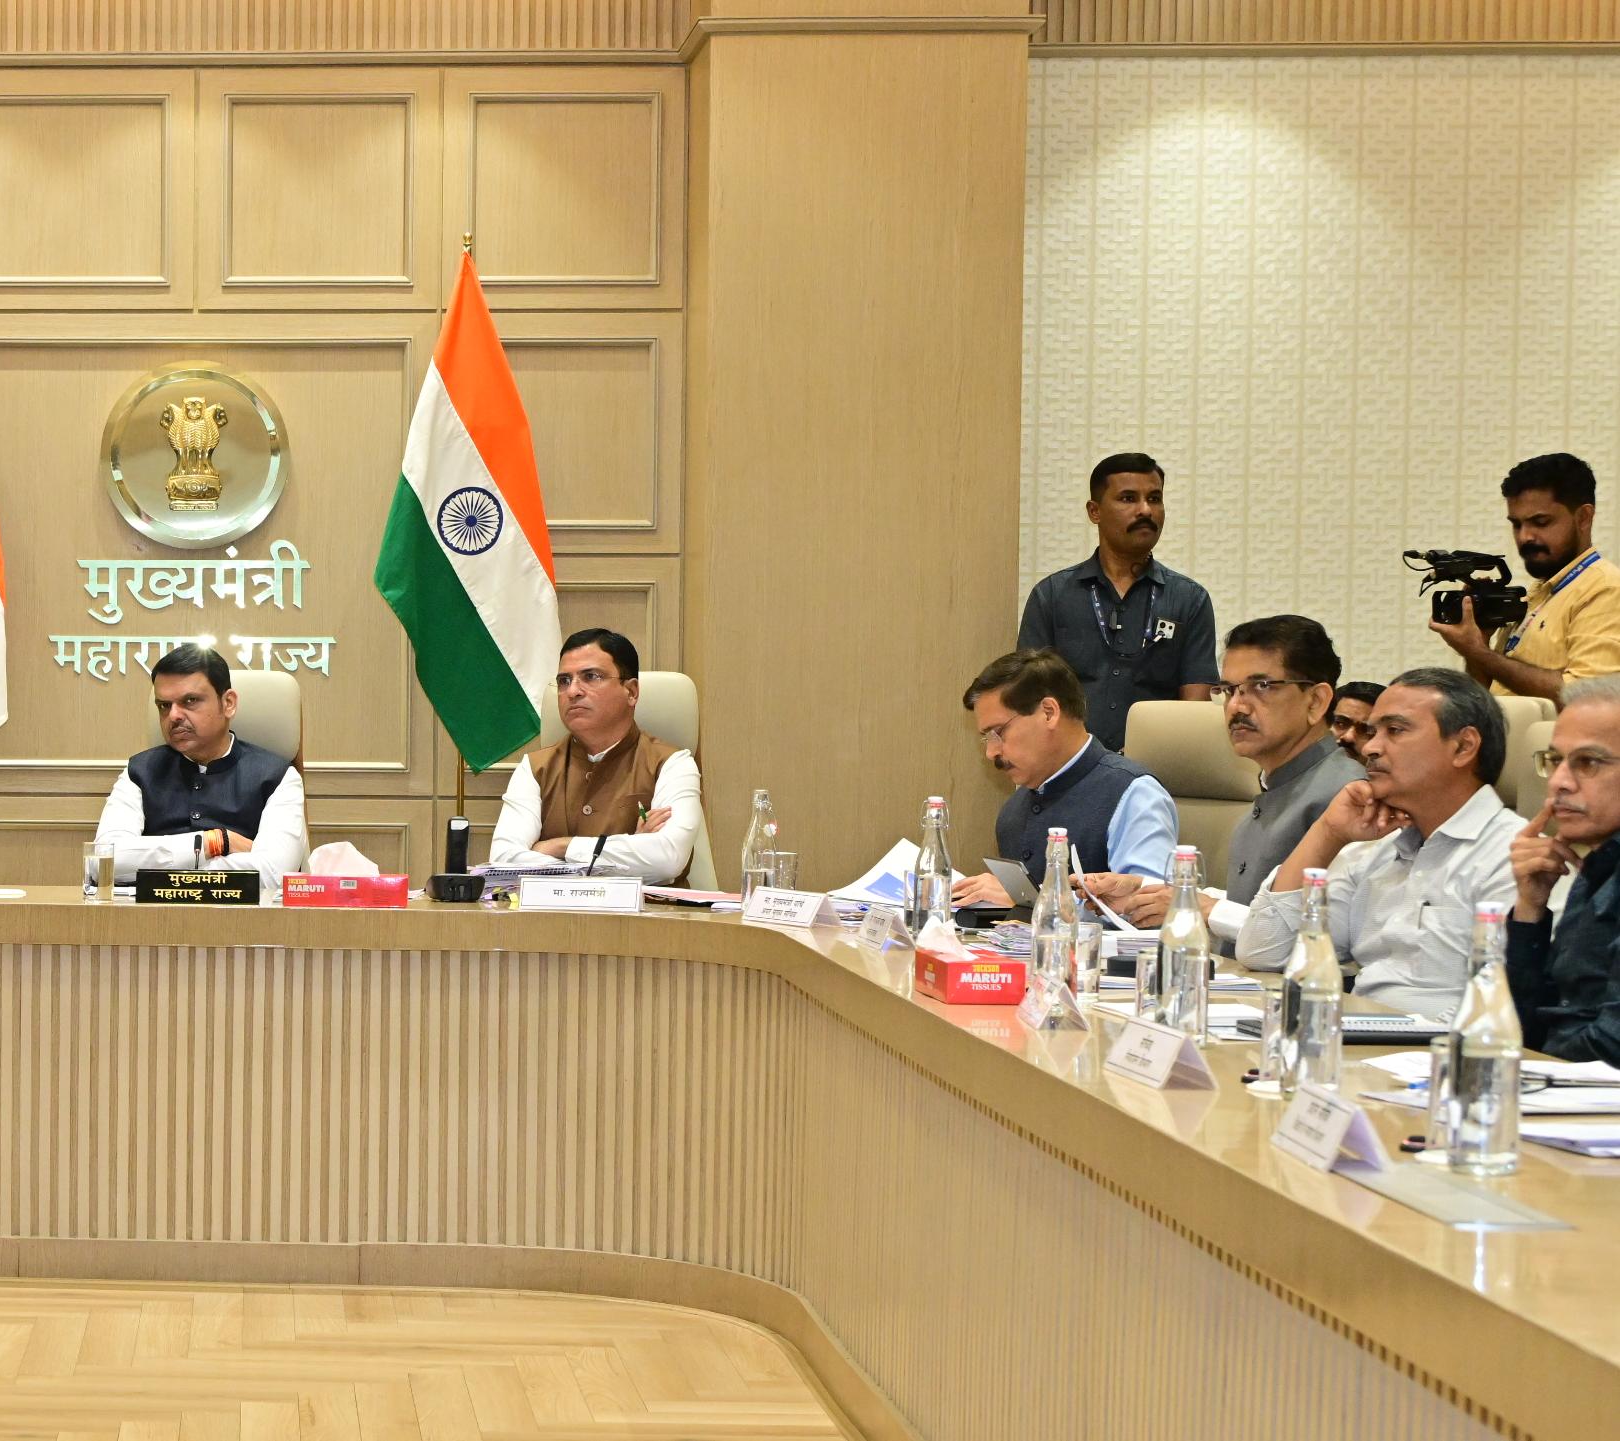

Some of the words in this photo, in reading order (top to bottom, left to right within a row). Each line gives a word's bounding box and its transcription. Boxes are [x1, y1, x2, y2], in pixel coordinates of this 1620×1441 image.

[77, 540, 311, 625] मुख्यमंत्री
[49, 635, 216, 681] महारा
[229, 635, 337, 677] राज्य
[168, 871, 228, 887] मुख्यमंत्री
[153, 889, 203, 901] महाराष्ट्र
[210, 890, 242, 899] राज्य
[569, 886, 606, 898] राज्यमंत्री
[961, 973, 1012, 984] MARUTI
